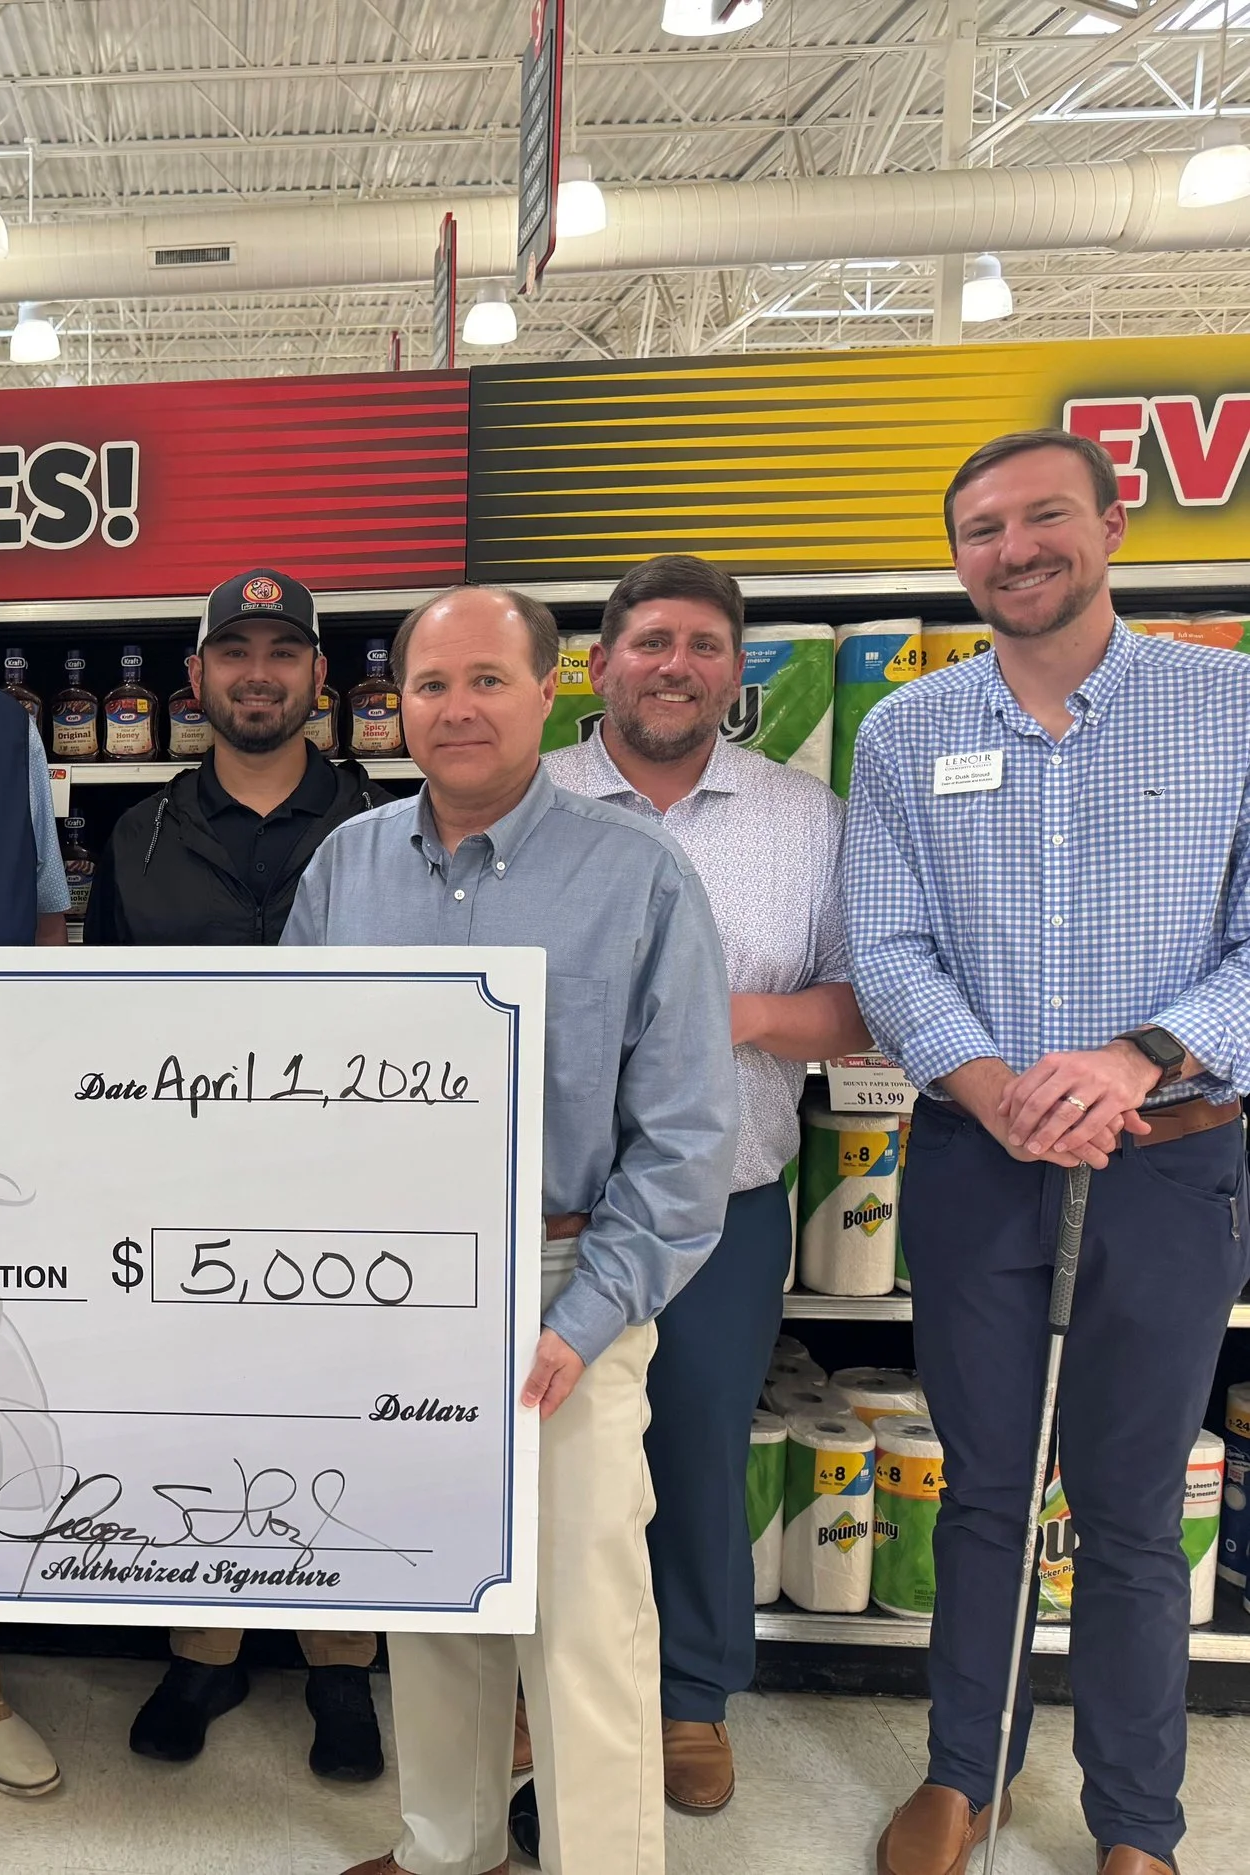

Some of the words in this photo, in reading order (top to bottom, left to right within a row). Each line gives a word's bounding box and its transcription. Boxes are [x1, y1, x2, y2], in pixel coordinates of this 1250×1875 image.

[58, 731, 91, 740] Original
[363, 730, 390, 738] Honey
[945, 754, 992, 766] LENOIR
[75, 1072, 149, 1101] Date
[153, 1052, 255, 1118] April
[339, 1054, 469, 1106] 2026
[857, 1091, 904, 1106] $13.99
[843, 1203, 893, 1230] Bounty
[111, 1236, 145, 1293] $
[180, 1238, 413, 1305] 5,000
[368, 1393, 479, 1424] Dollars
[817, 1520, 869, 1547] Bounty
[40, 1555, 197, 1585] Authorized
[202, 1558, 341, 1594] Signature
